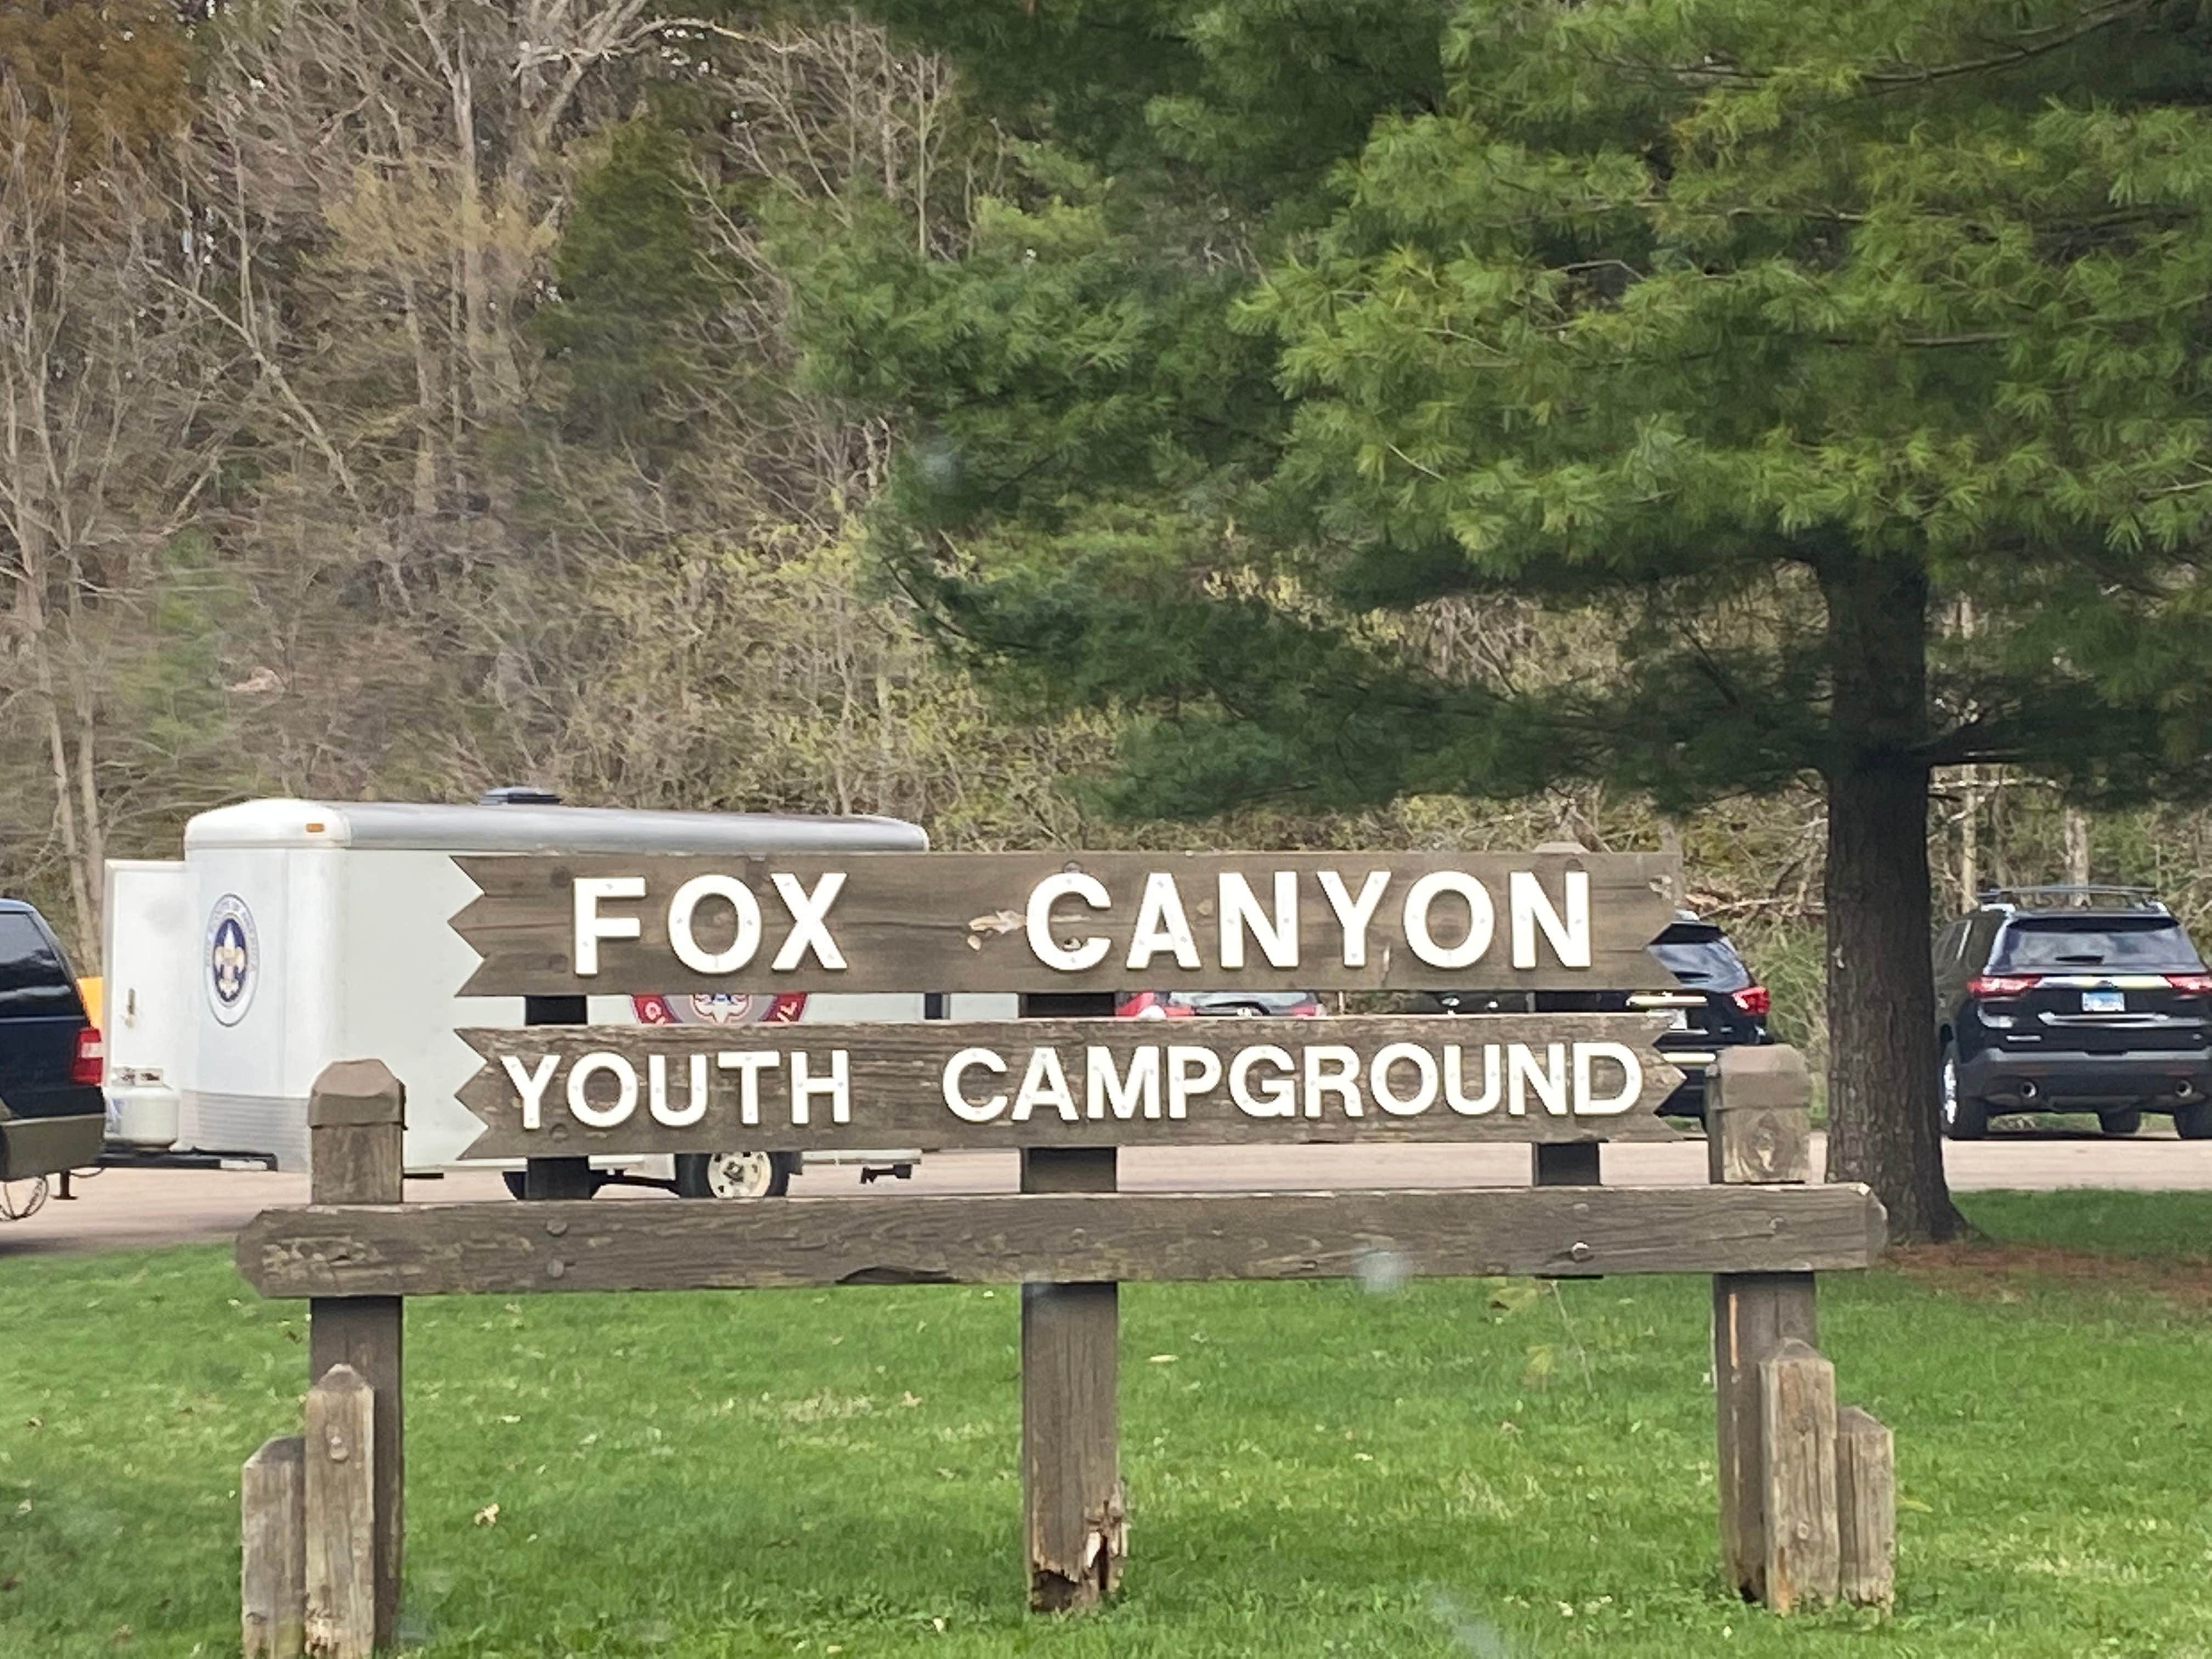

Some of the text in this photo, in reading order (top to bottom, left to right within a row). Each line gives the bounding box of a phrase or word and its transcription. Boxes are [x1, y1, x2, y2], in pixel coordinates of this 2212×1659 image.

[574, 871, 1592, 975] FOX CANYON
[500, 1042, 1643, 1129] YOUTH CAMPGROUND
